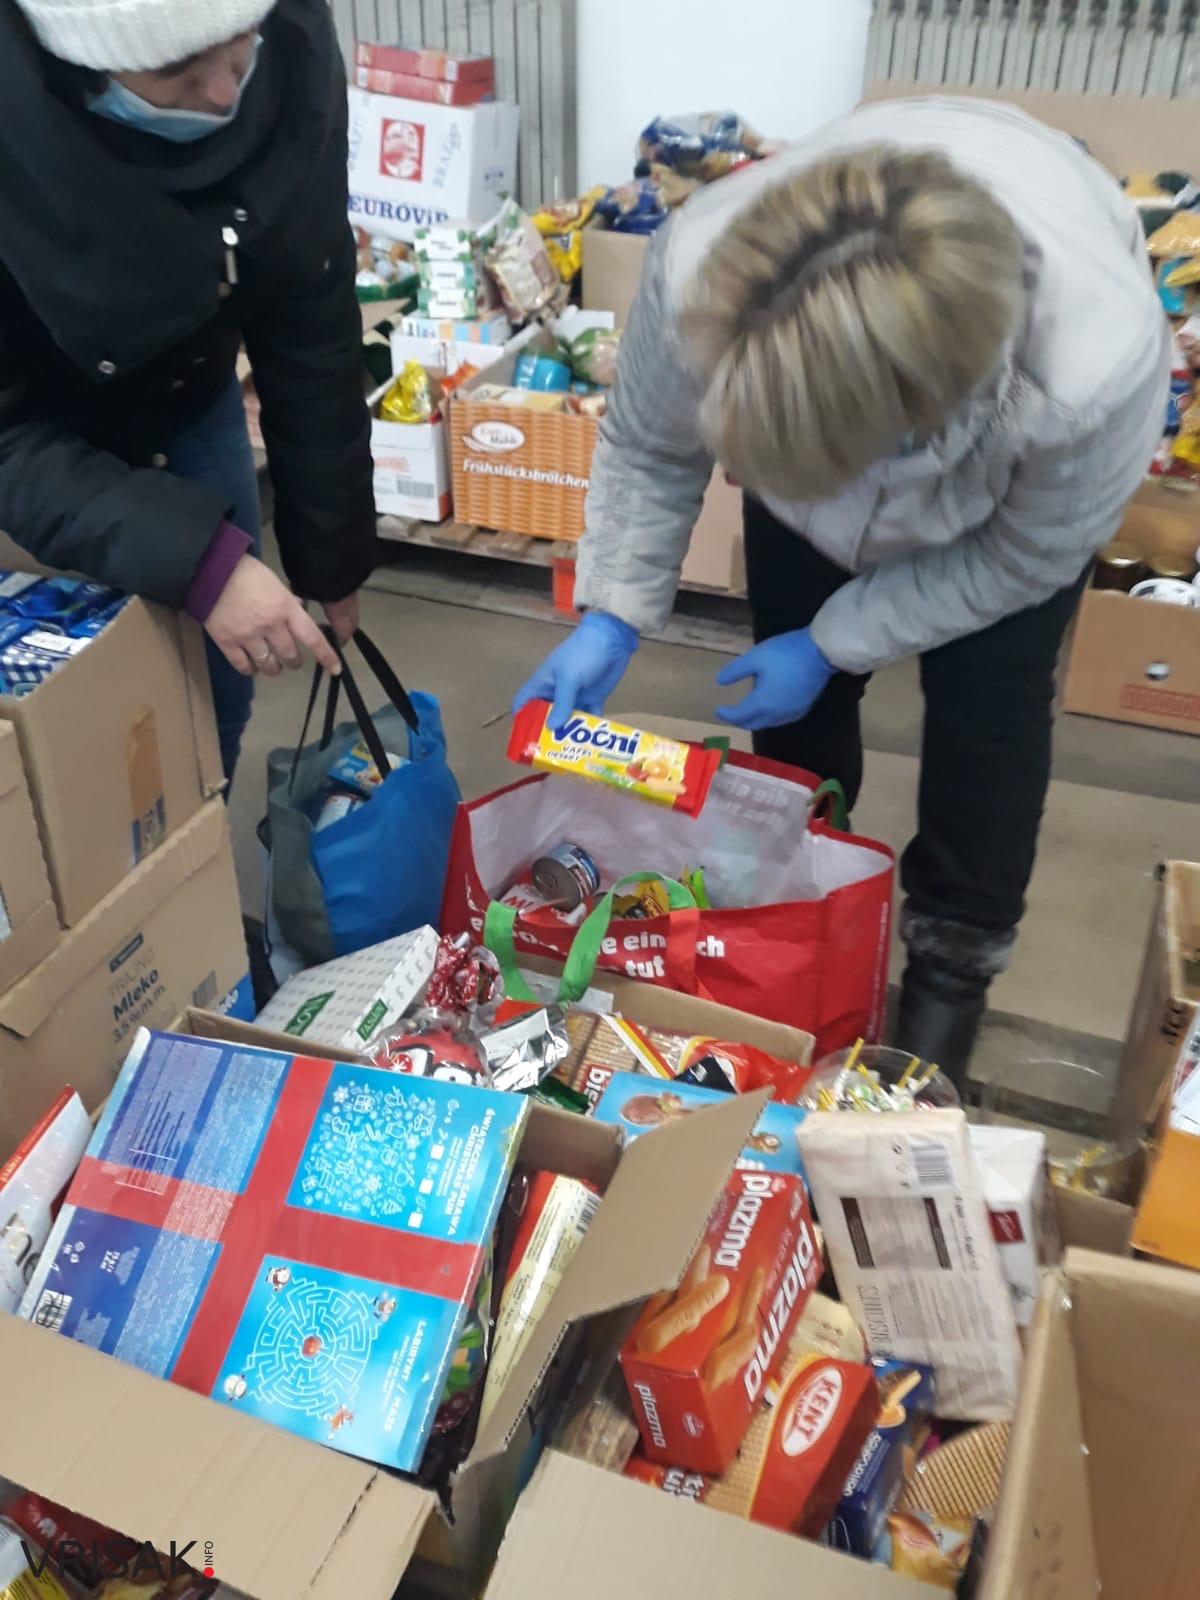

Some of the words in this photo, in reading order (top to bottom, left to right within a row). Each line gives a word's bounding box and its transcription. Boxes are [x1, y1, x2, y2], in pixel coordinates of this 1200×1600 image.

[112, 968, 159, 1022] Mleko
[744, 1219, 814, 1403] plazma
[800, 1376, 838, 1442] KENT
